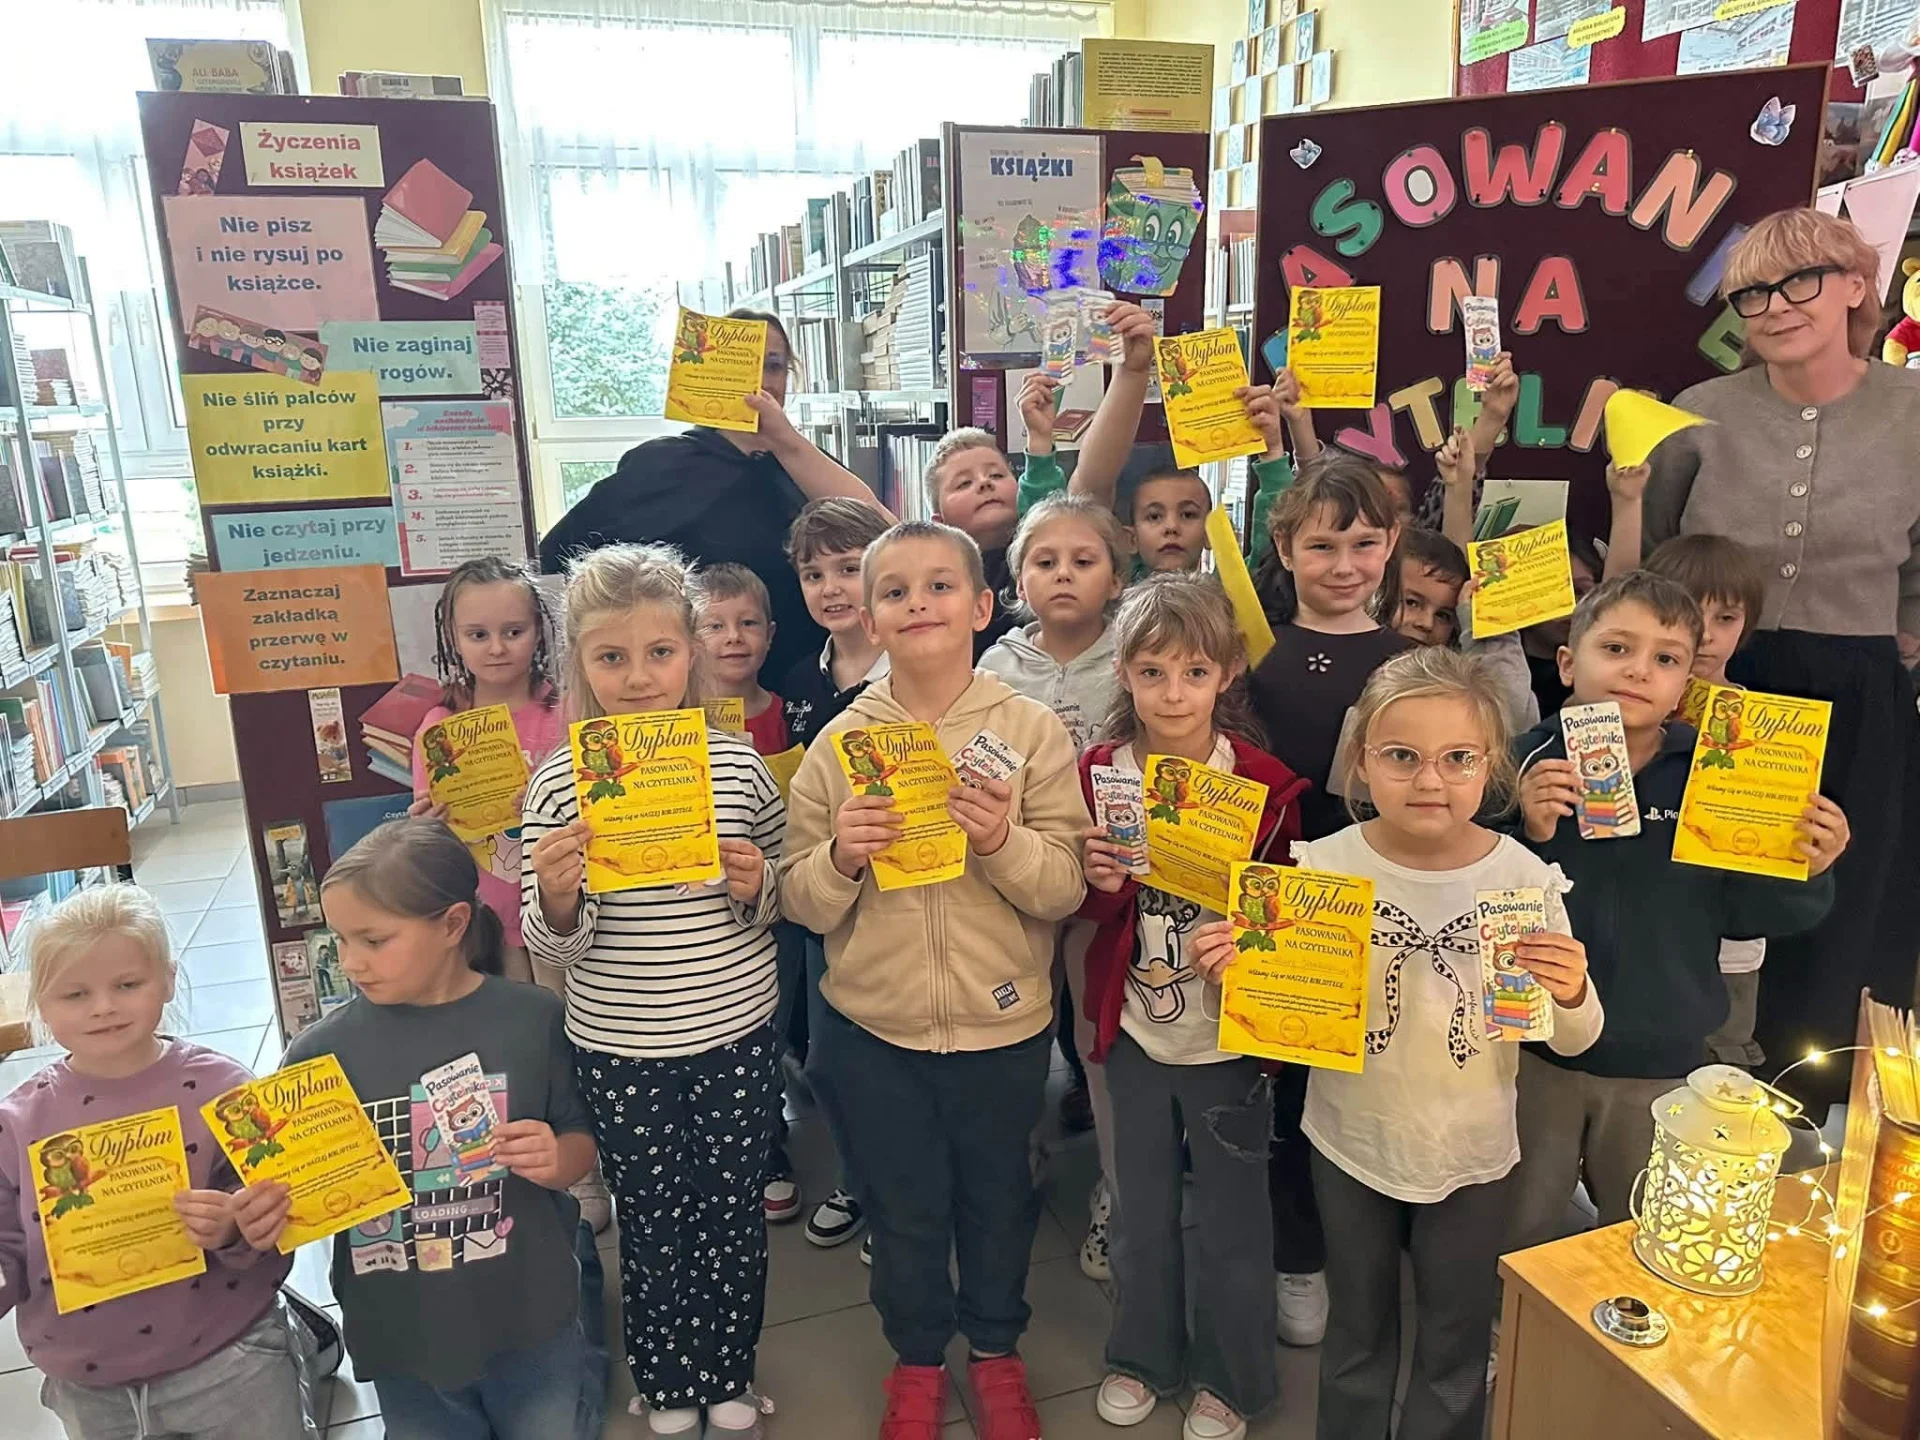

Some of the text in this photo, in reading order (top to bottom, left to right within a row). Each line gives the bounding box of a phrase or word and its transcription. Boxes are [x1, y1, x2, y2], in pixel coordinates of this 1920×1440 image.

[211, 68, 240, 77] BABA
[257, 128, 361, 151] Życzenia
[269, 162, 358, 182] książek
[990, 152, 1074, 182] KSIĄŻKI
[220, 215, 312, 237] Nie pisz
[196, 246, 344, 266] i nie rysuj po
[227, 274, 322, 295] książce.
[1427, 252, 1592, 335] NA
[1325, 294, 1377, 319] Dyplom
[710, 322, 761, 346] Dyplom
[352, 337, 389, 354] Nie
[394, 336, 473, 356] zaginaj
[1185, 338, 1236, 367] Dyplom
[379, 363, 453, 381] rogów.
[202, 390, 356, 408] Nie śliń palców
[263, 416, 305, 433] przy
[205, 437, 368, 457] odwracaniu kart
[404, 442, 413, 451] 1.
[252, 463, 329, 480] książki.
[404, 464, 418, 474] 2.
[408, 489, 423, 500] 3.
[411, 511, 425, 521] 4.
[228, 518, 386, 539] Nie czytaj przy
[415, 534, 427, 543] 5.
[1508, 530, 1564, 558] Dyplom
[262, 545, 360, 567] jedzeniu.
[243, 585, 342, 602] Zaznaczaj
[252, 608, 339, 626] zakładką
[249, 630, 349, 650] przerwę w
[258, 652, 346, 671] czytaniu.
[450, 716, 510, 746] Dyplom
[1563, 712, 1620, 732] Pasowanie
[1747, 704, 1824, 740] Dyplom
[624, 723, 702, 760] Dyplom
[878, 734, 939, 765] Dyplom
[1567, 732, 1624, 752] Czytelnika
[960, 747, 1002, 779] Czytelnik
[973, 735, 1018, 772] Pasowanie
[1754, 746, 1803, 760] PASOWANIA
[640, 763, 690, 775] PASOWANIA
[1743, 757, 1809, 774] NA CZYTELNIKA
[633, 775, 698, 789] NA CZYTELNIKA
[909, 774, 949, 786] CZYTELNIKA
[1093, 773, 1141, 787] Pasowanie
[1095, 789, 1142, 803] Czytelnika
[1193, 771, 1261, 814] Dyplom
[1198, 809, 1242, 830] PASOWANIA
[1187, 818, 1245, 844] NA CZYTELNIKA
[1284, 879, 1367, 920] Dyplom
[1477, 900, 1543, 919] Pasowanie
[1295, 926, 1347, 942] PASOWANIA
[1284, 938, 1354, 958] NA CZYTELNIKA
[425, 1063, 480, 1096] Pasowanie
[262, 1070, 344, 1114] Dyplom
[432, 1082, 487, 1113] Czytelnika
[291, 1104, 341, 1127] PASOWANIA
[288, 1113, 354, 1142] NA CZYTELNIKA
[89, 1125, 175, 1167] Dyplom
[109, 1163, 163, 1183] PASOWANIA
[101, 1173, 174, 1198] NA CZYTELNIKA
